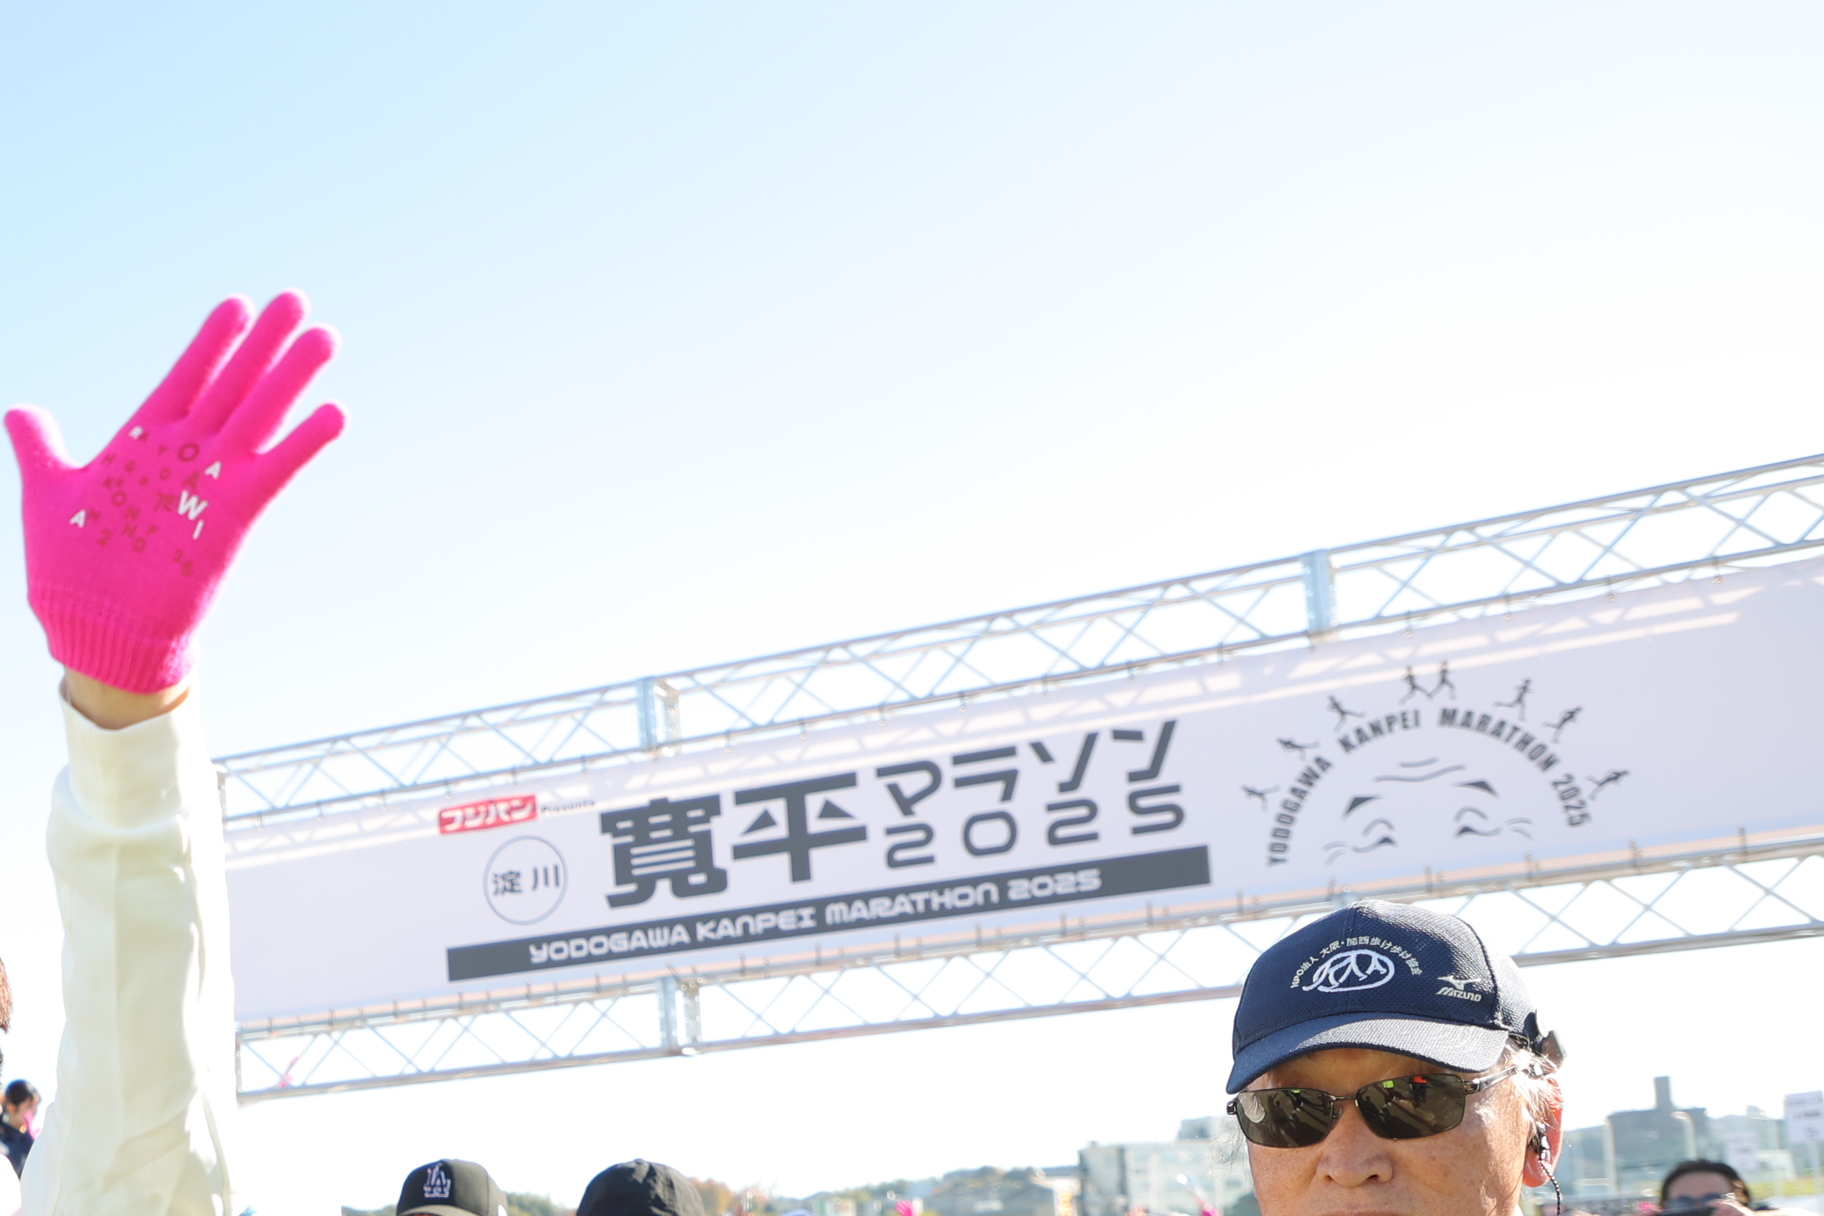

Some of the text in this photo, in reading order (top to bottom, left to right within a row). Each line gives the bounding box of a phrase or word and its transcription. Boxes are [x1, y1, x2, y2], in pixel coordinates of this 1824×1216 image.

[1267, 706, 1592, 867] YODOGAWA KANPEI MARATHON 2025
[440, 798, 536, 832] フジパン
[884, 783, 1186, 870] 2025
[491, 863, 562, 897] 淀川
[529, 868, 1102, 964] YODOGAWA KANPEI MARATHON 2025
[1435, 986, 1482, 1002] MIZUNO
[423, 1163, 451, 1198] LA
